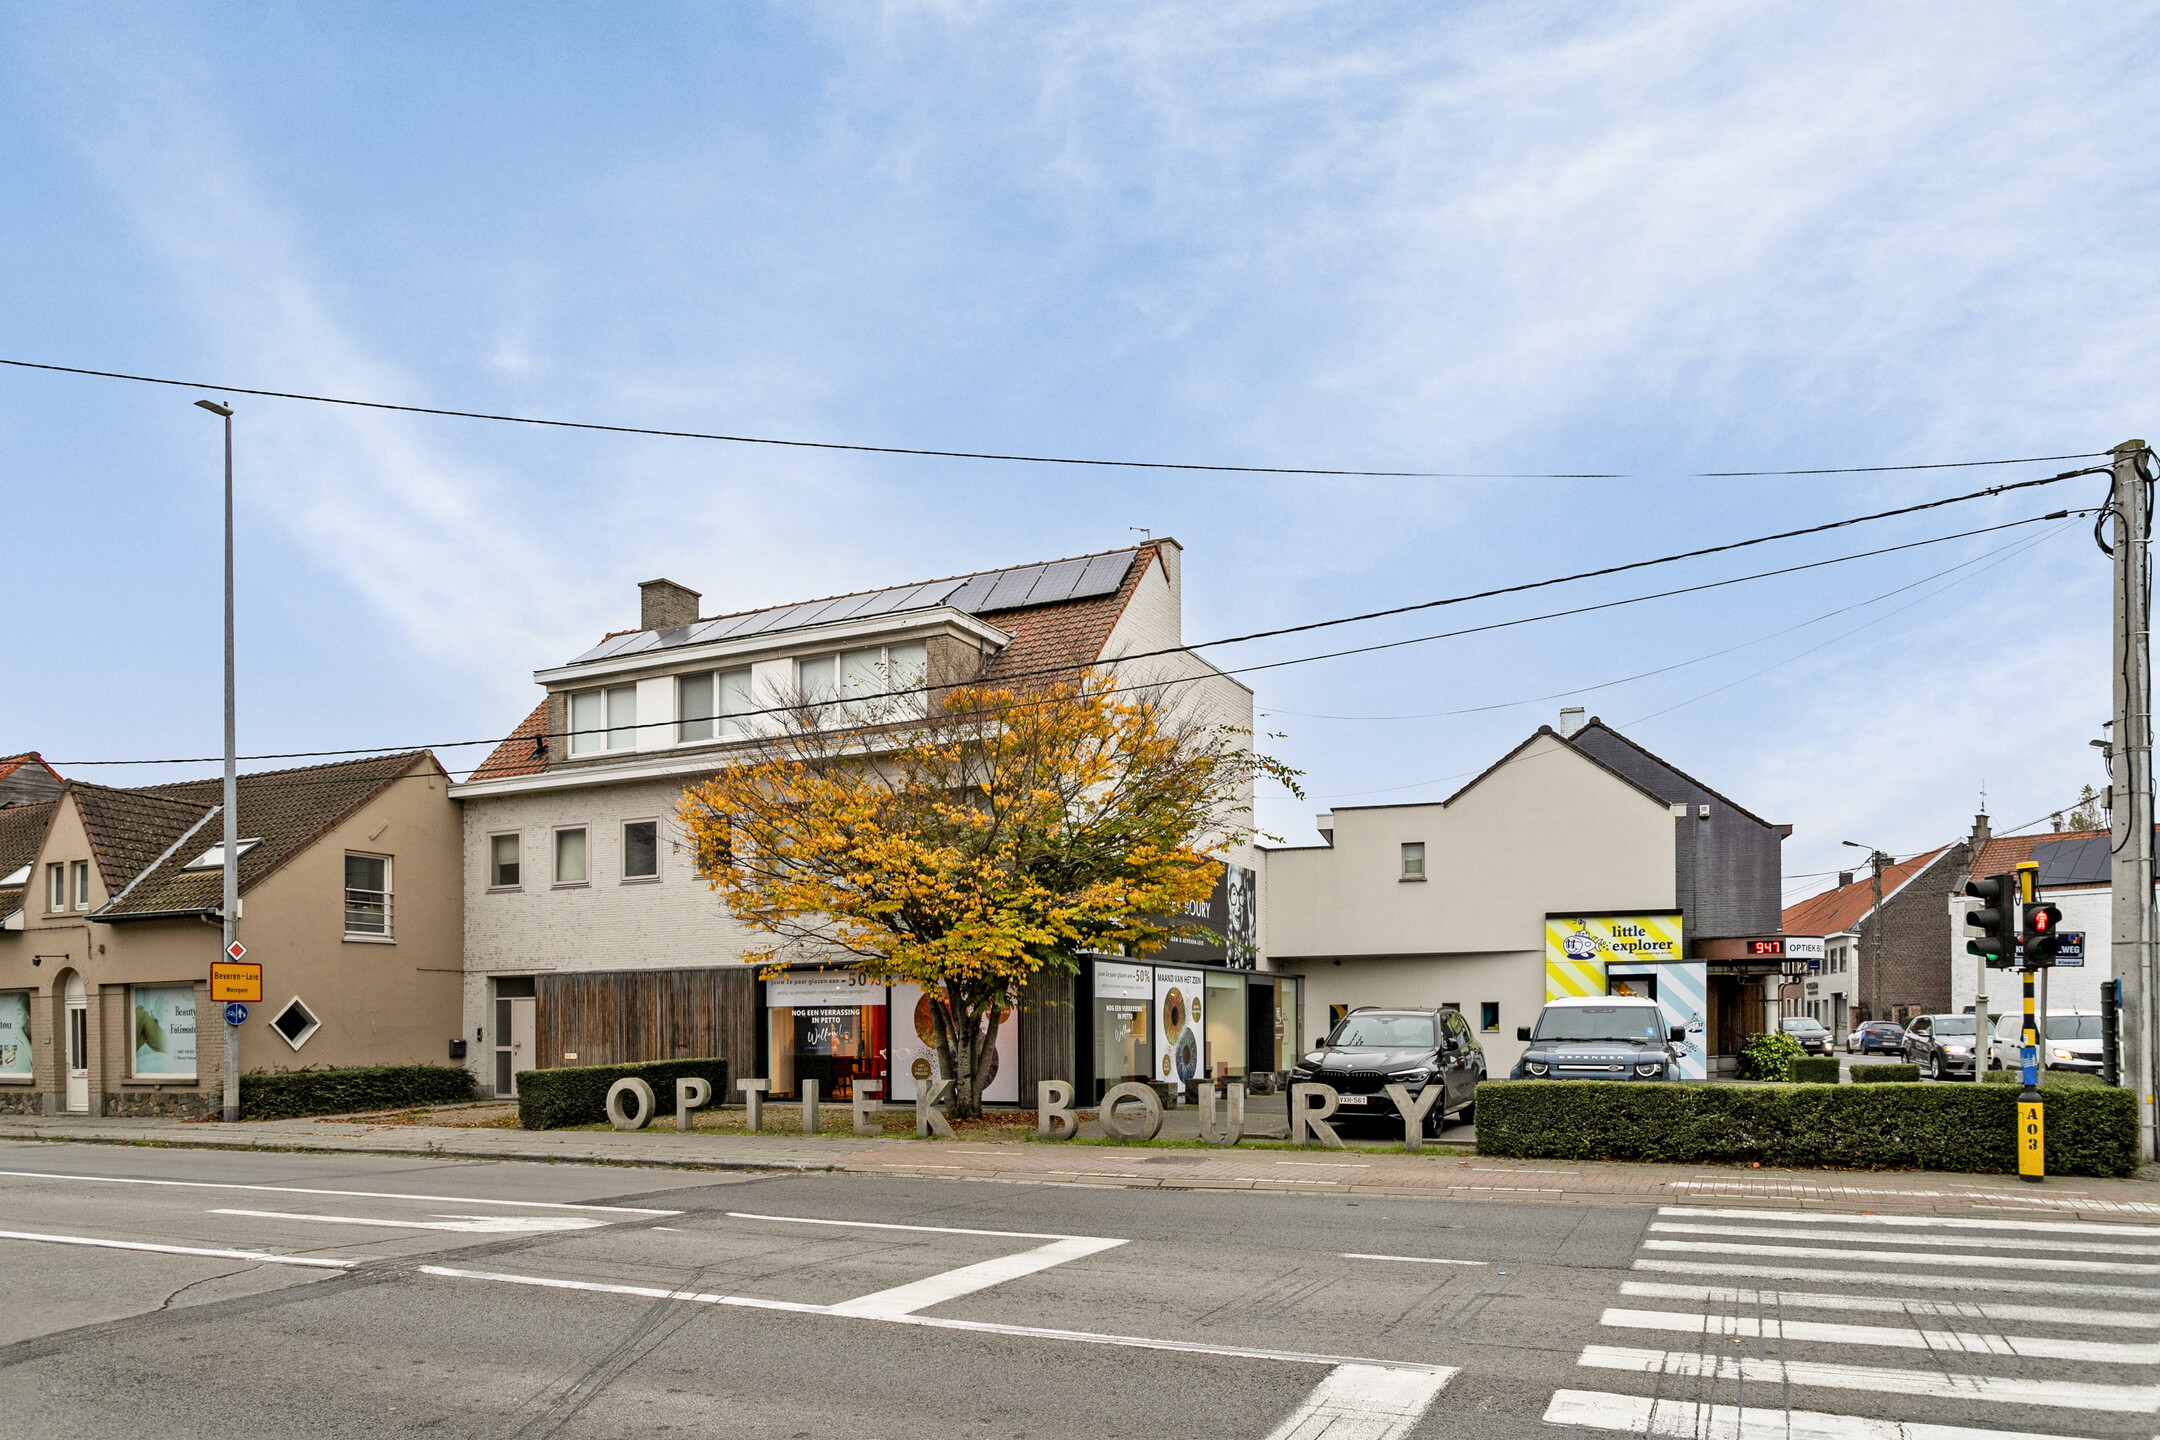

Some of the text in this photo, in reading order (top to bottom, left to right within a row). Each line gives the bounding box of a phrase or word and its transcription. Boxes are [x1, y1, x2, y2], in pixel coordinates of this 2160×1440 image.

[1612, 926, 1646, 937] little
[1612, 940, 1673, 954] explorer
[1790, 944, 1816, 952] OPTIEK
[214, 972, 258, 980] Beveren-Leie
[1157, 974, 1174, 982] MAAND
[1174, 974, 1183, 983] VAN
[1192, 976, 1201, 984] ZIEN
[606, 1078, 1443, 1151] OPTIEK BOURY
